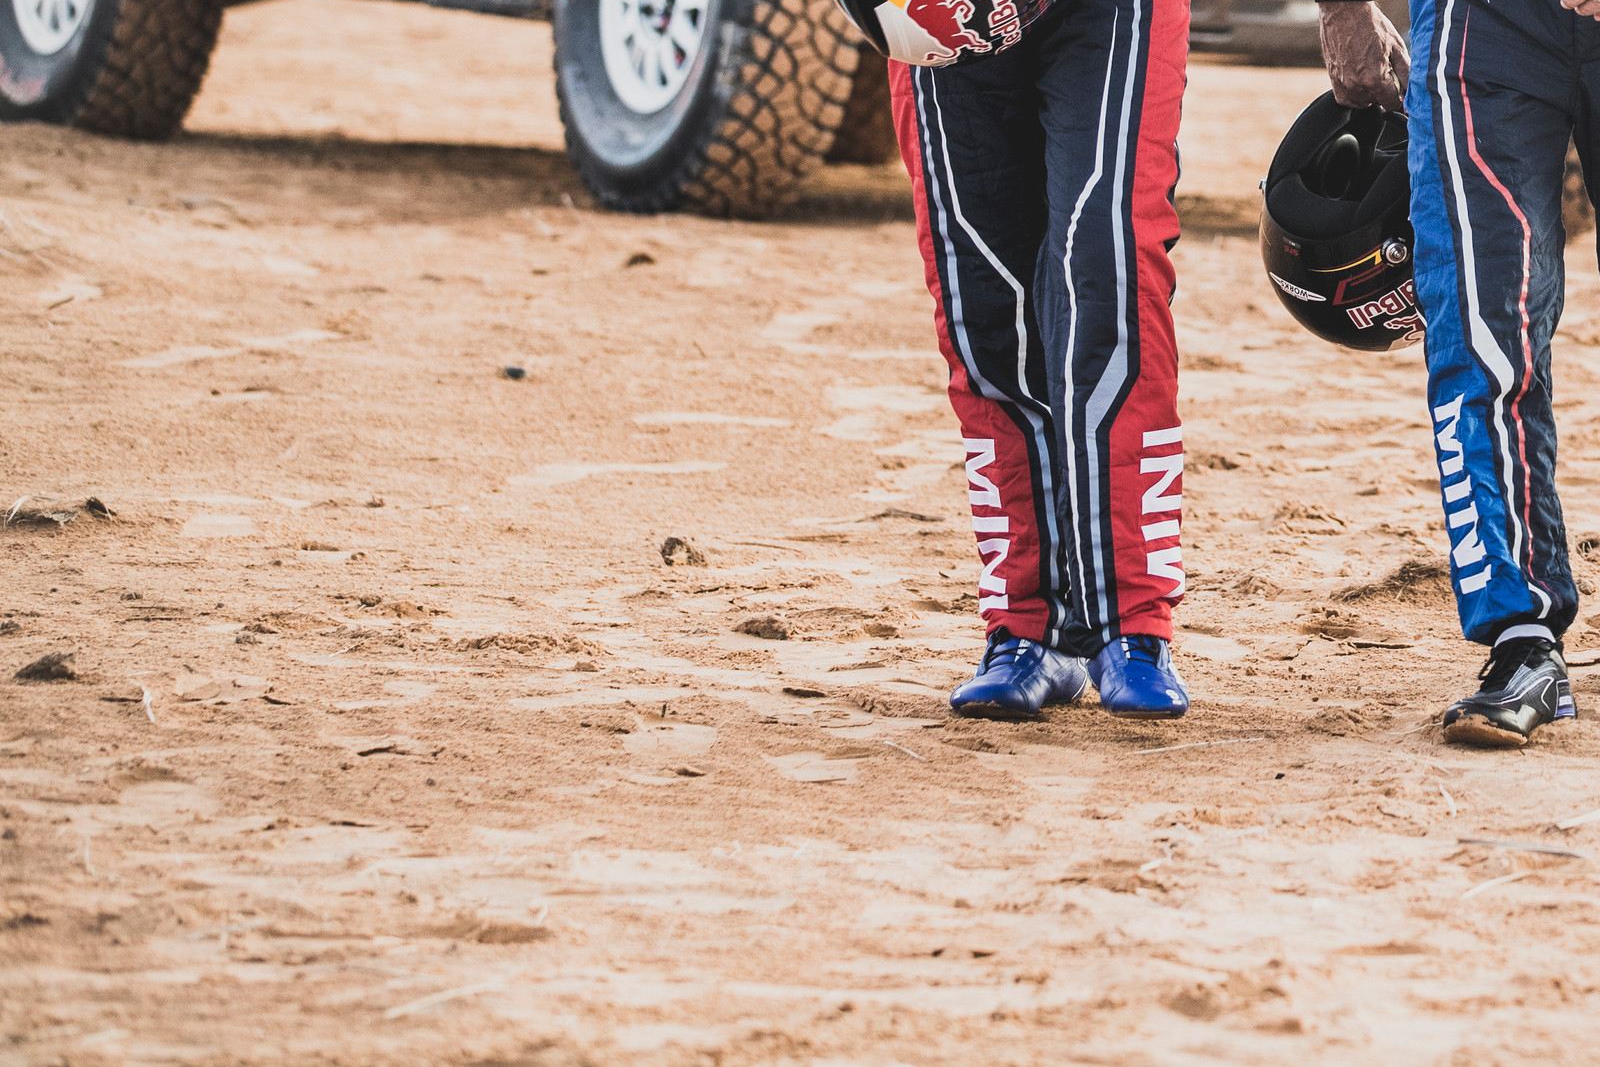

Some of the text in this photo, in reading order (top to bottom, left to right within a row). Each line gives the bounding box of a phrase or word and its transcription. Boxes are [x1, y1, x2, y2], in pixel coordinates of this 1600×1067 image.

[1346, 290, 1407, 329] Bull
[962, 438, 1012, 614] MINI
[1140, 426, 1186, 598] MINI
[1434, 393, 1492, 595] MINI
